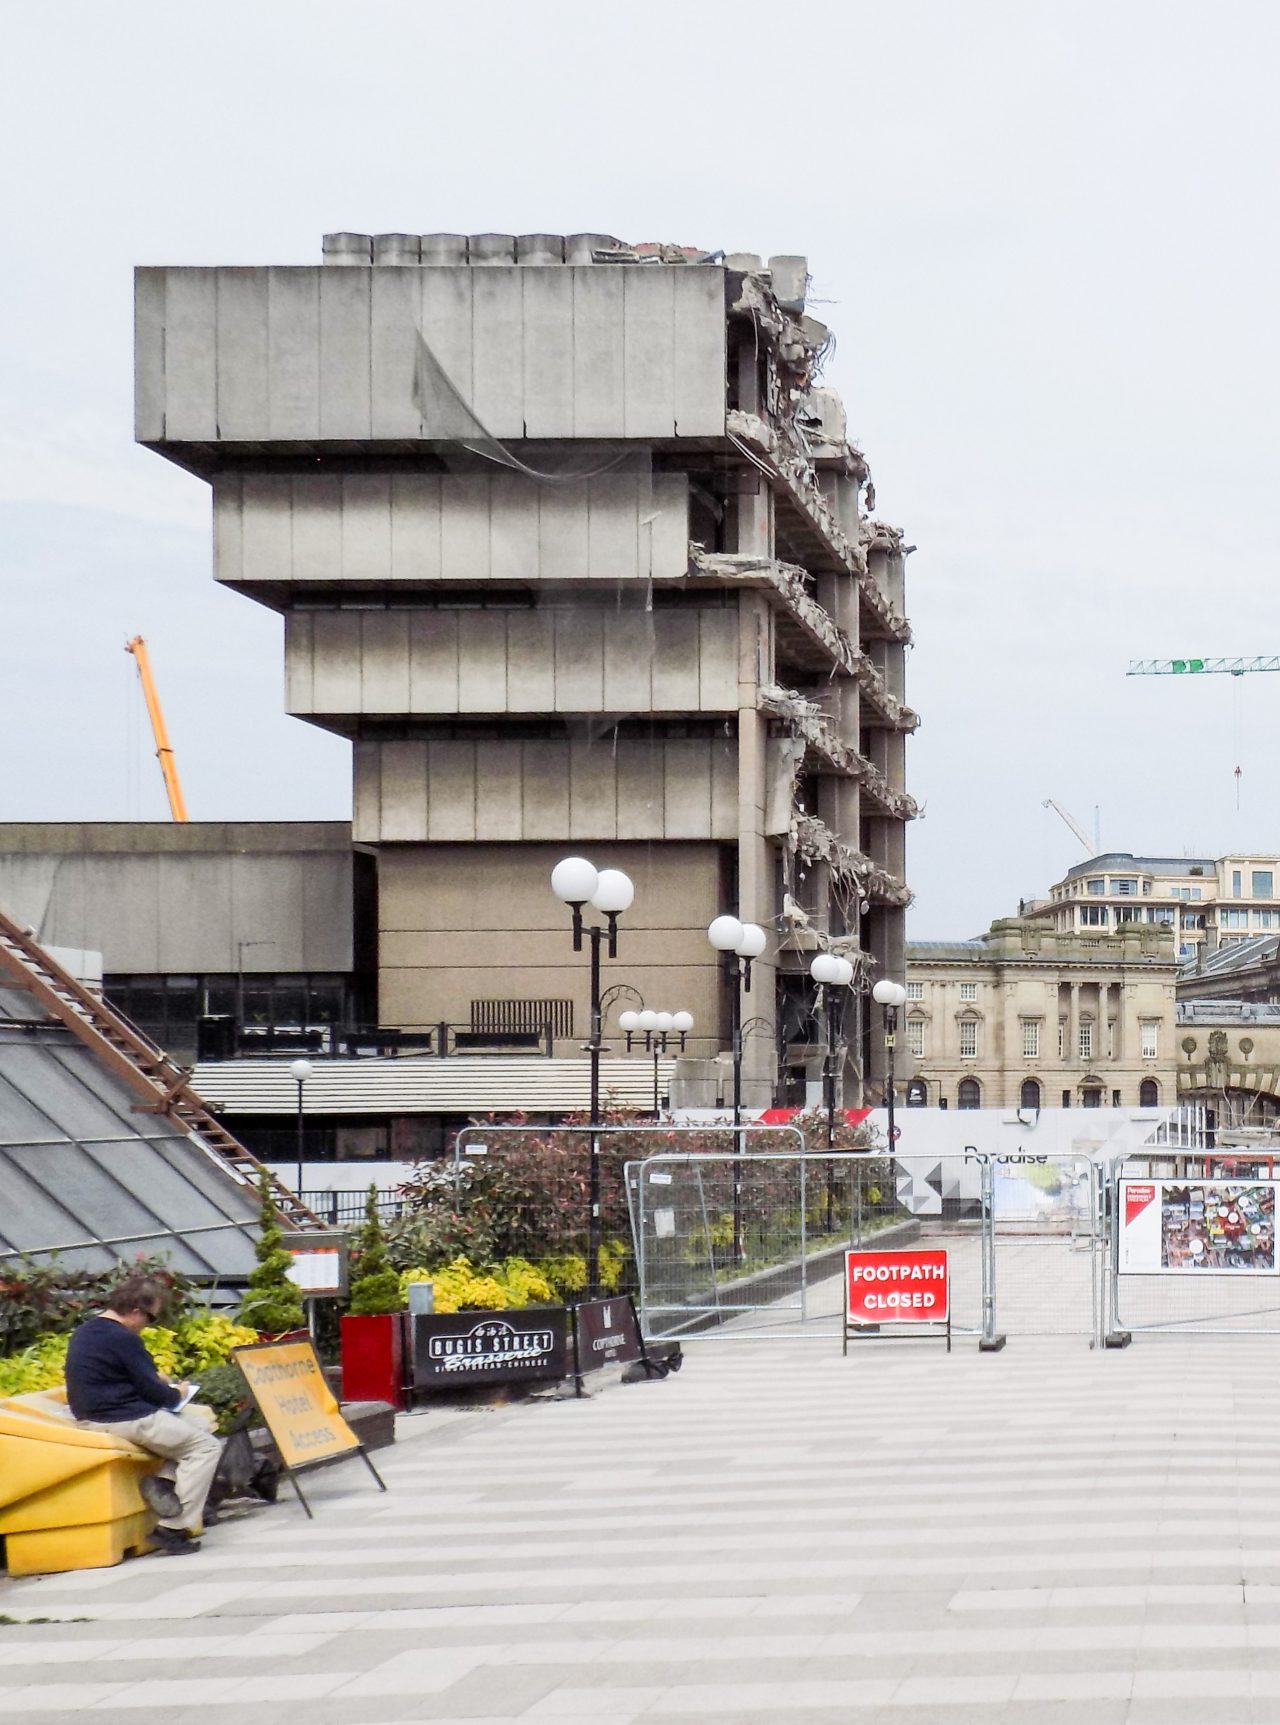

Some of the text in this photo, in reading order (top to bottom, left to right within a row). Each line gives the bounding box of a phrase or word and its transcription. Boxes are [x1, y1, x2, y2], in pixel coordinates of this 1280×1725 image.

[964, 1145, 1048, 1164] Paradise
[853, 1264, 945, 1282] FOOTPATH
[863, 1292, 935, 1309] CLOSED
[434, 1335, 550, 1355] BUGIS STREET
[442, 1346, 542, 1369] Brasserie
